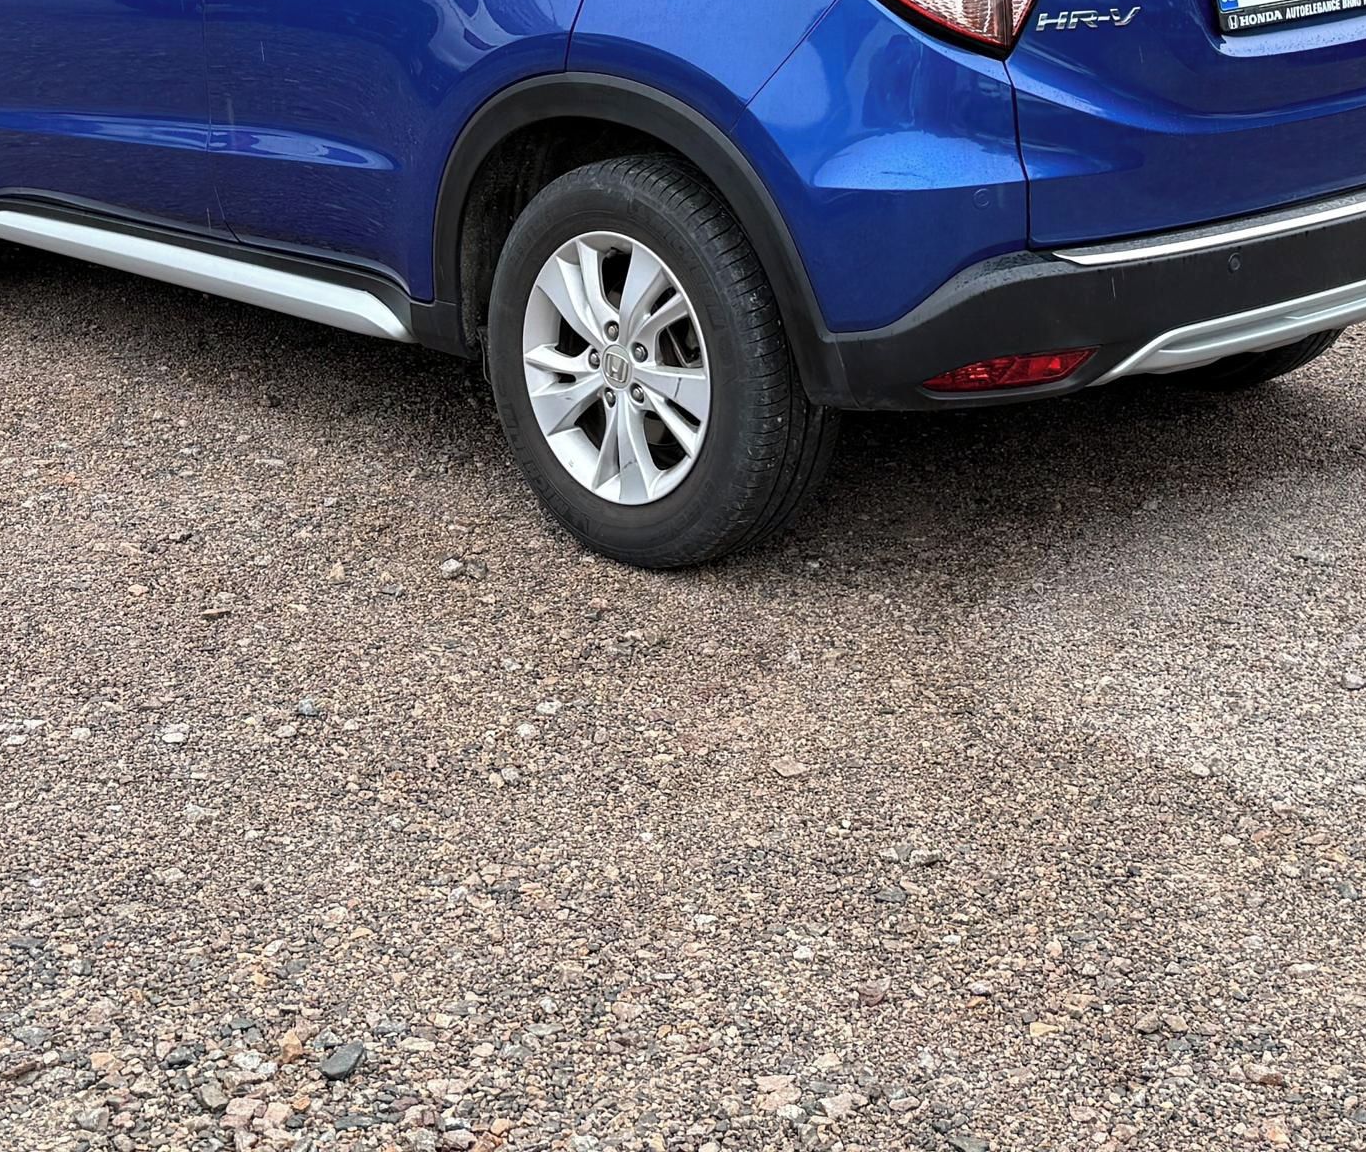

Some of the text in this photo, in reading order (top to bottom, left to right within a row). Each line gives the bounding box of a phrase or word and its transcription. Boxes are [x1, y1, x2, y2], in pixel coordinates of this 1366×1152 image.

[1036, 6, 1141, 31] HR-V
[1239, 10, 1283, 26] HONDA
[1285, 0, 1341, 20] AUTOELEGANCE
